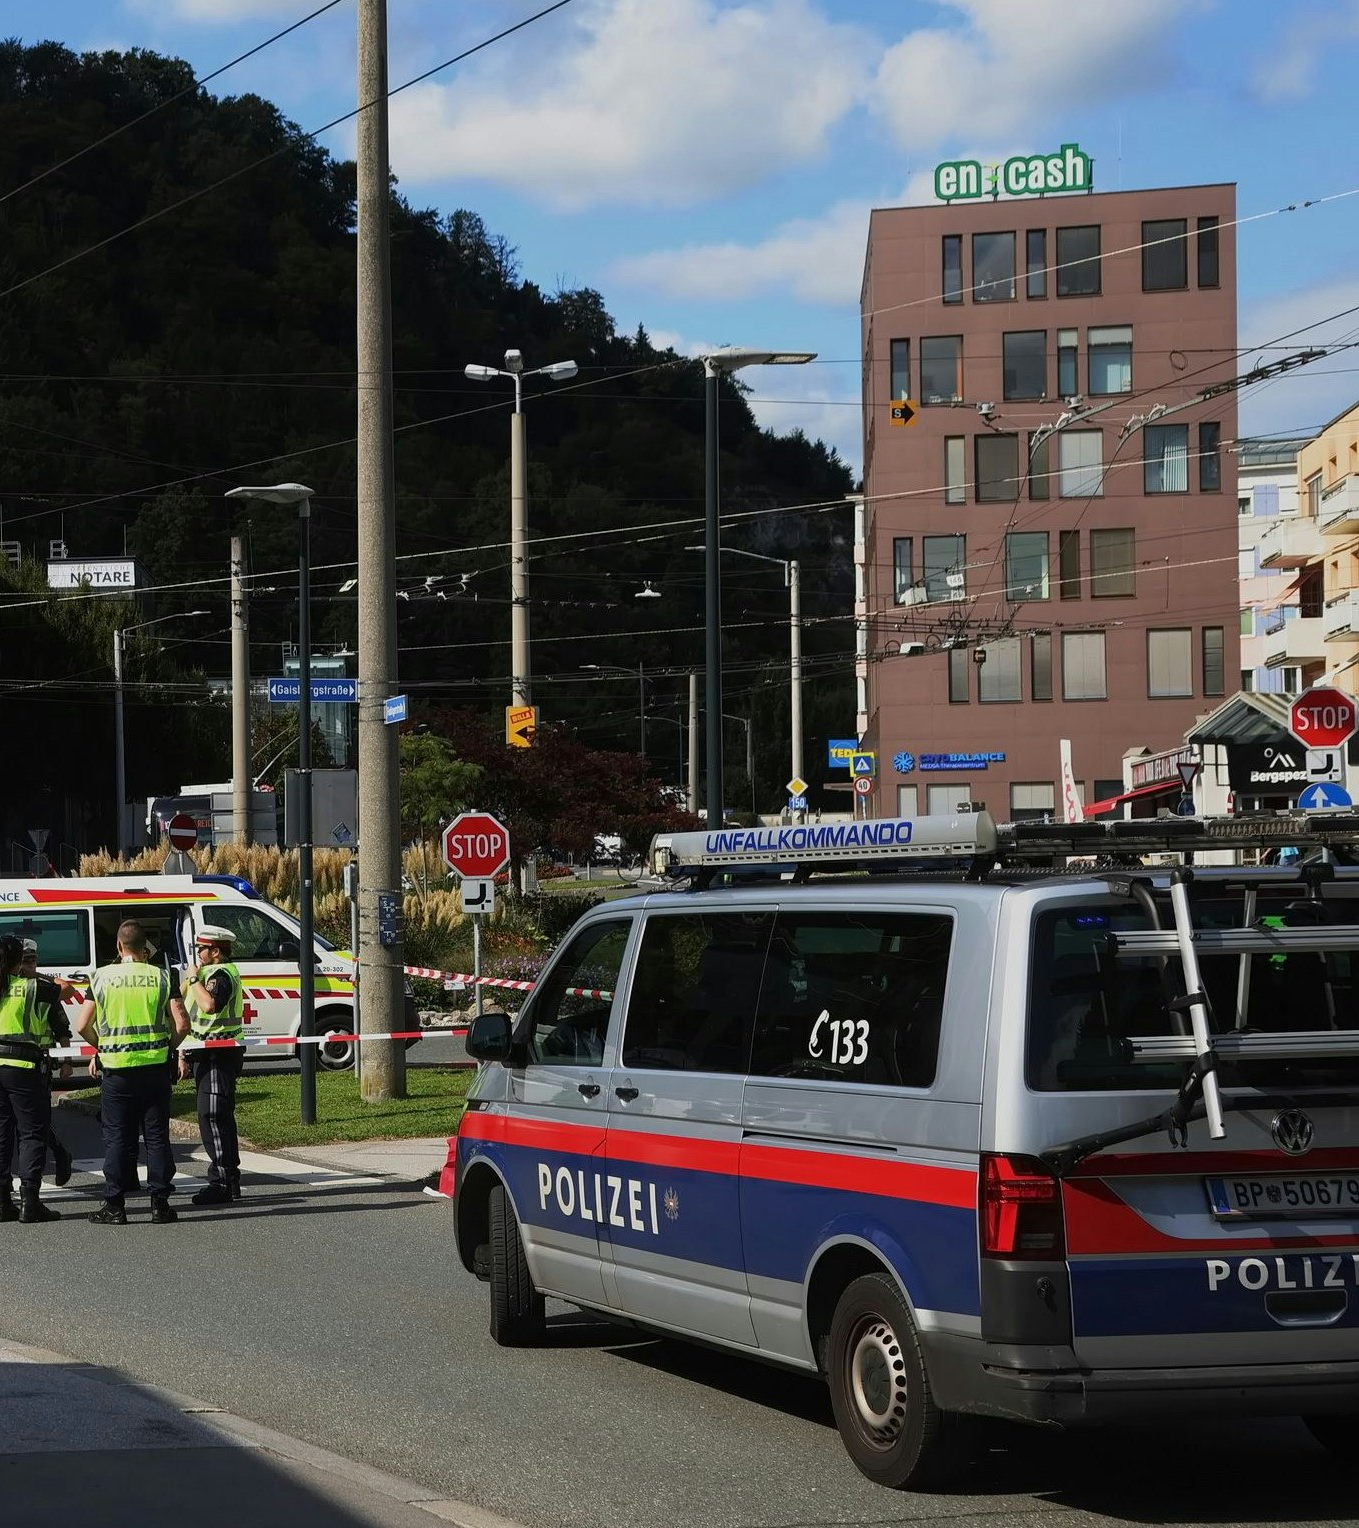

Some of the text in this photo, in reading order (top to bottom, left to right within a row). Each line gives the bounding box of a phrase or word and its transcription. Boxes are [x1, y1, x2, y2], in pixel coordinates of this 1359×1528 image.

[70, 571, 130, 583] NOTARE
[277, 684, 348, 697] Gaisgstraße
[1296, 705, 1350, 731] STOP
[451, 834, 502, 859] STOP
[706, 821, 913, 853] UNFALLKOMMANDO
[109, 975, 158, 988] POLIZEI
[829, 1018, 869, 1065] 133
[538, 1162, 659, 1234] POLIZEI
[1233, 1179, 1359, 1207] BP 50679
